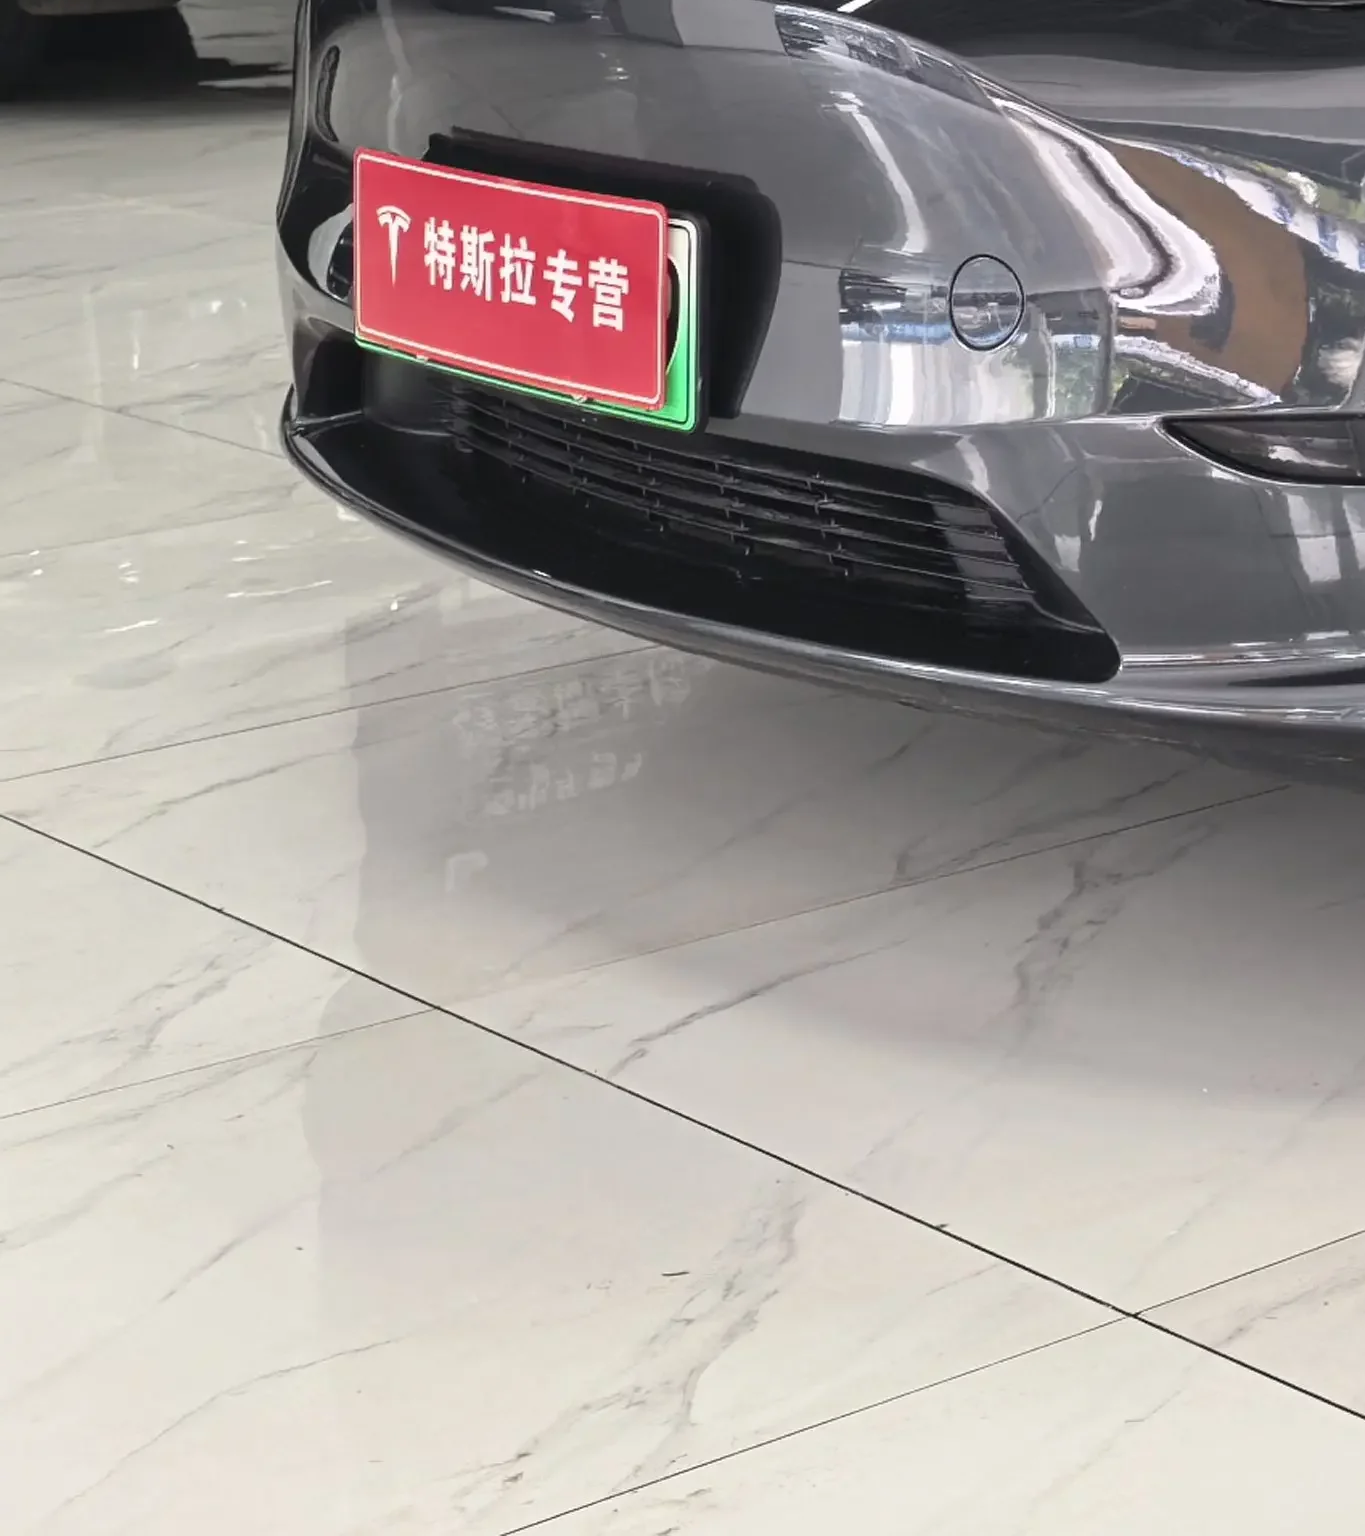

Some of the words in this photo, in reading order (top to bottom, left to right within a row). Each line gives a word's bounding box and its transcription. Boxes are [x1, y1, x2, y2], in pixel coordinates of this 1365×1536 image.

[423, 216, 630, 332] 特斯拉专营
